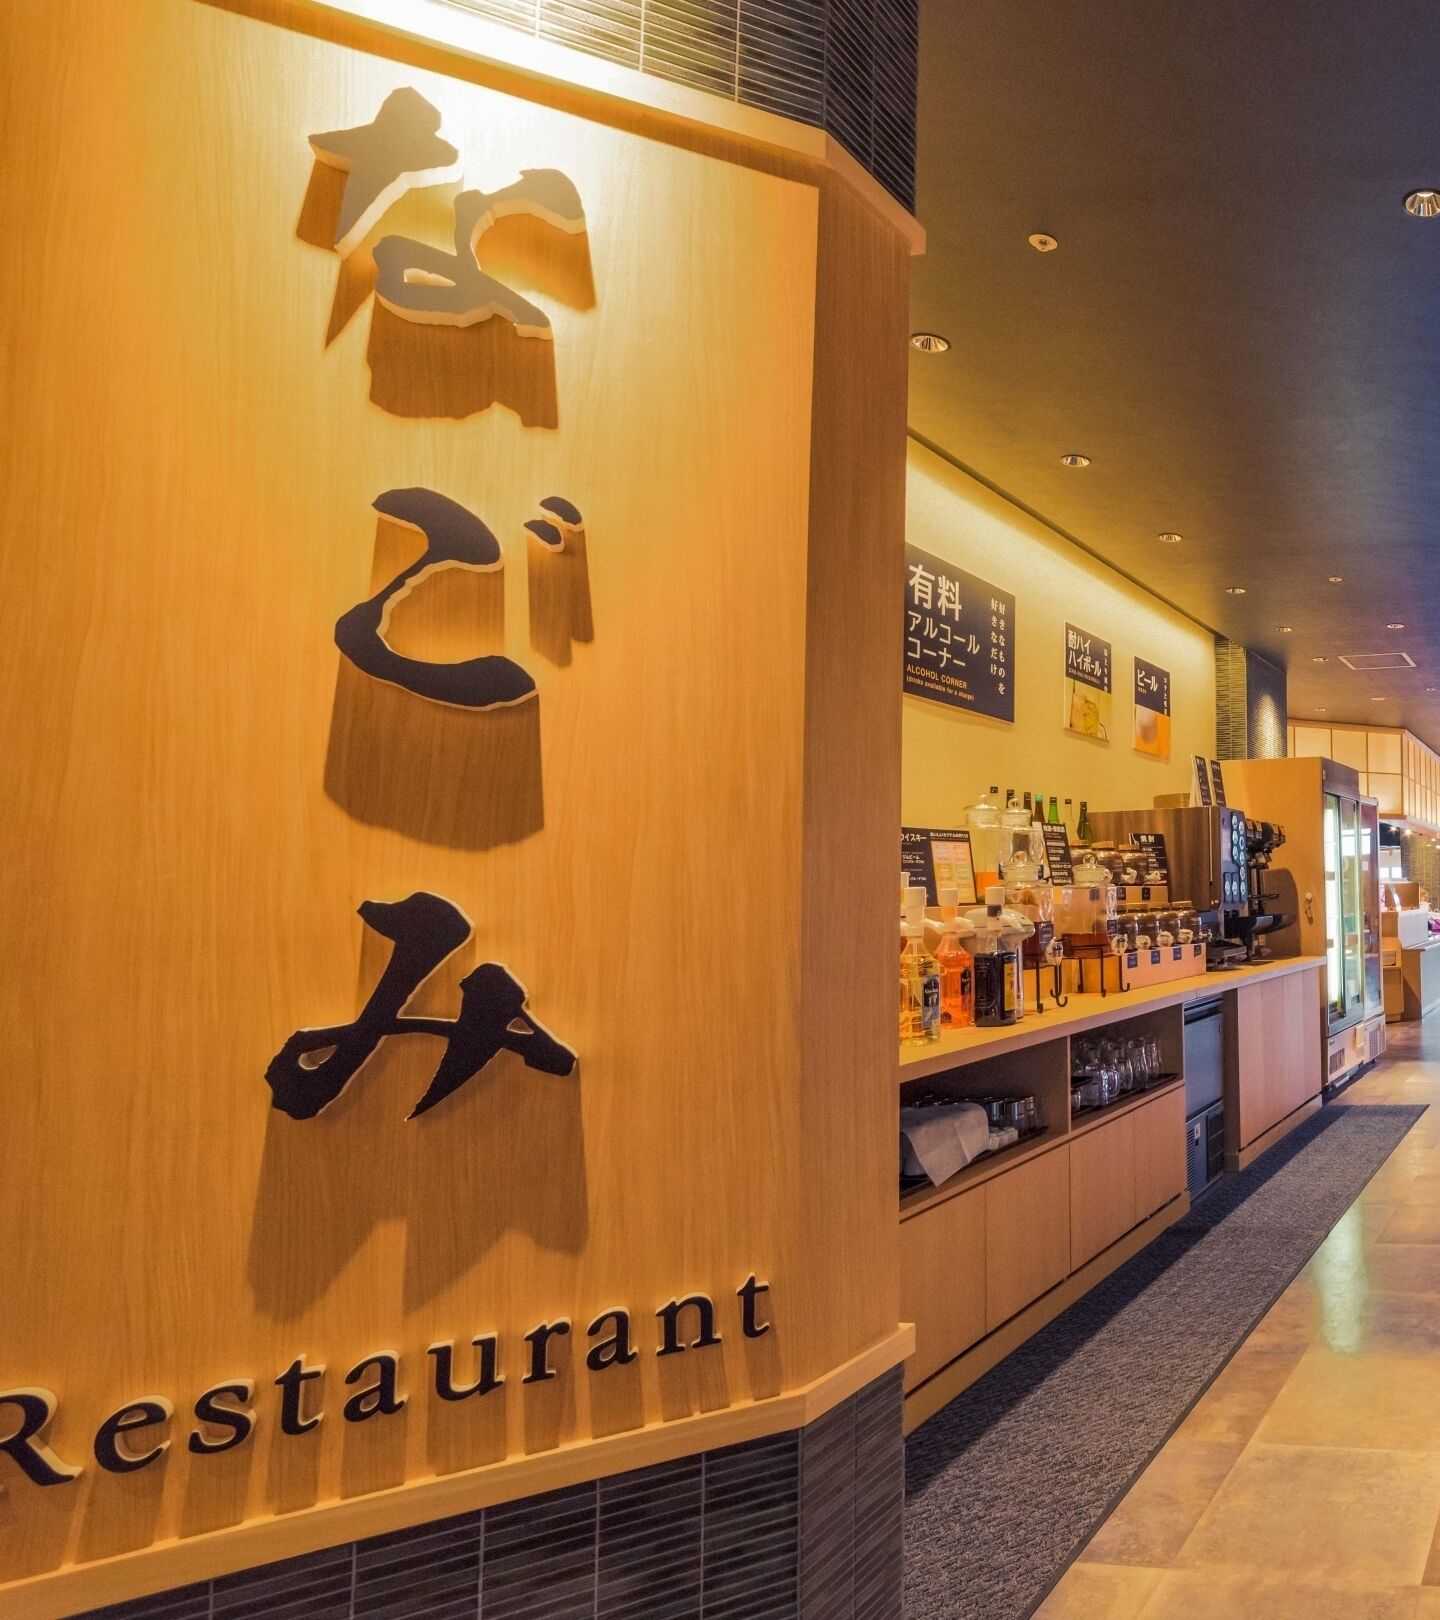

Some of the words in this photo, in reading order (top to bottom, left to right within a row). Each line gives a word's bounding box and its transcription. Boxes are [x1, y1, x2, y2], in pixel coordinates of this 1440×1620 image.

[264, 86, 588, 1122] なごみ
[908, 563, 962, 622] 有料
[907, 610, 980, 655] アルコール
[907, 636, 966, 669] コーナー
[990, 597, 999, 676] 好きなだけ
[998, 601, 1007, 696] 好きなものを
[906, 663, 940, 681] ALCOHOL
[941, 673, 968, 690] CORNER
[1068, 650, 1102, 677] ハイボール
[1137, 668, 1158, 692] ビール
[0, 1271, 772, 1487] Restaurant
